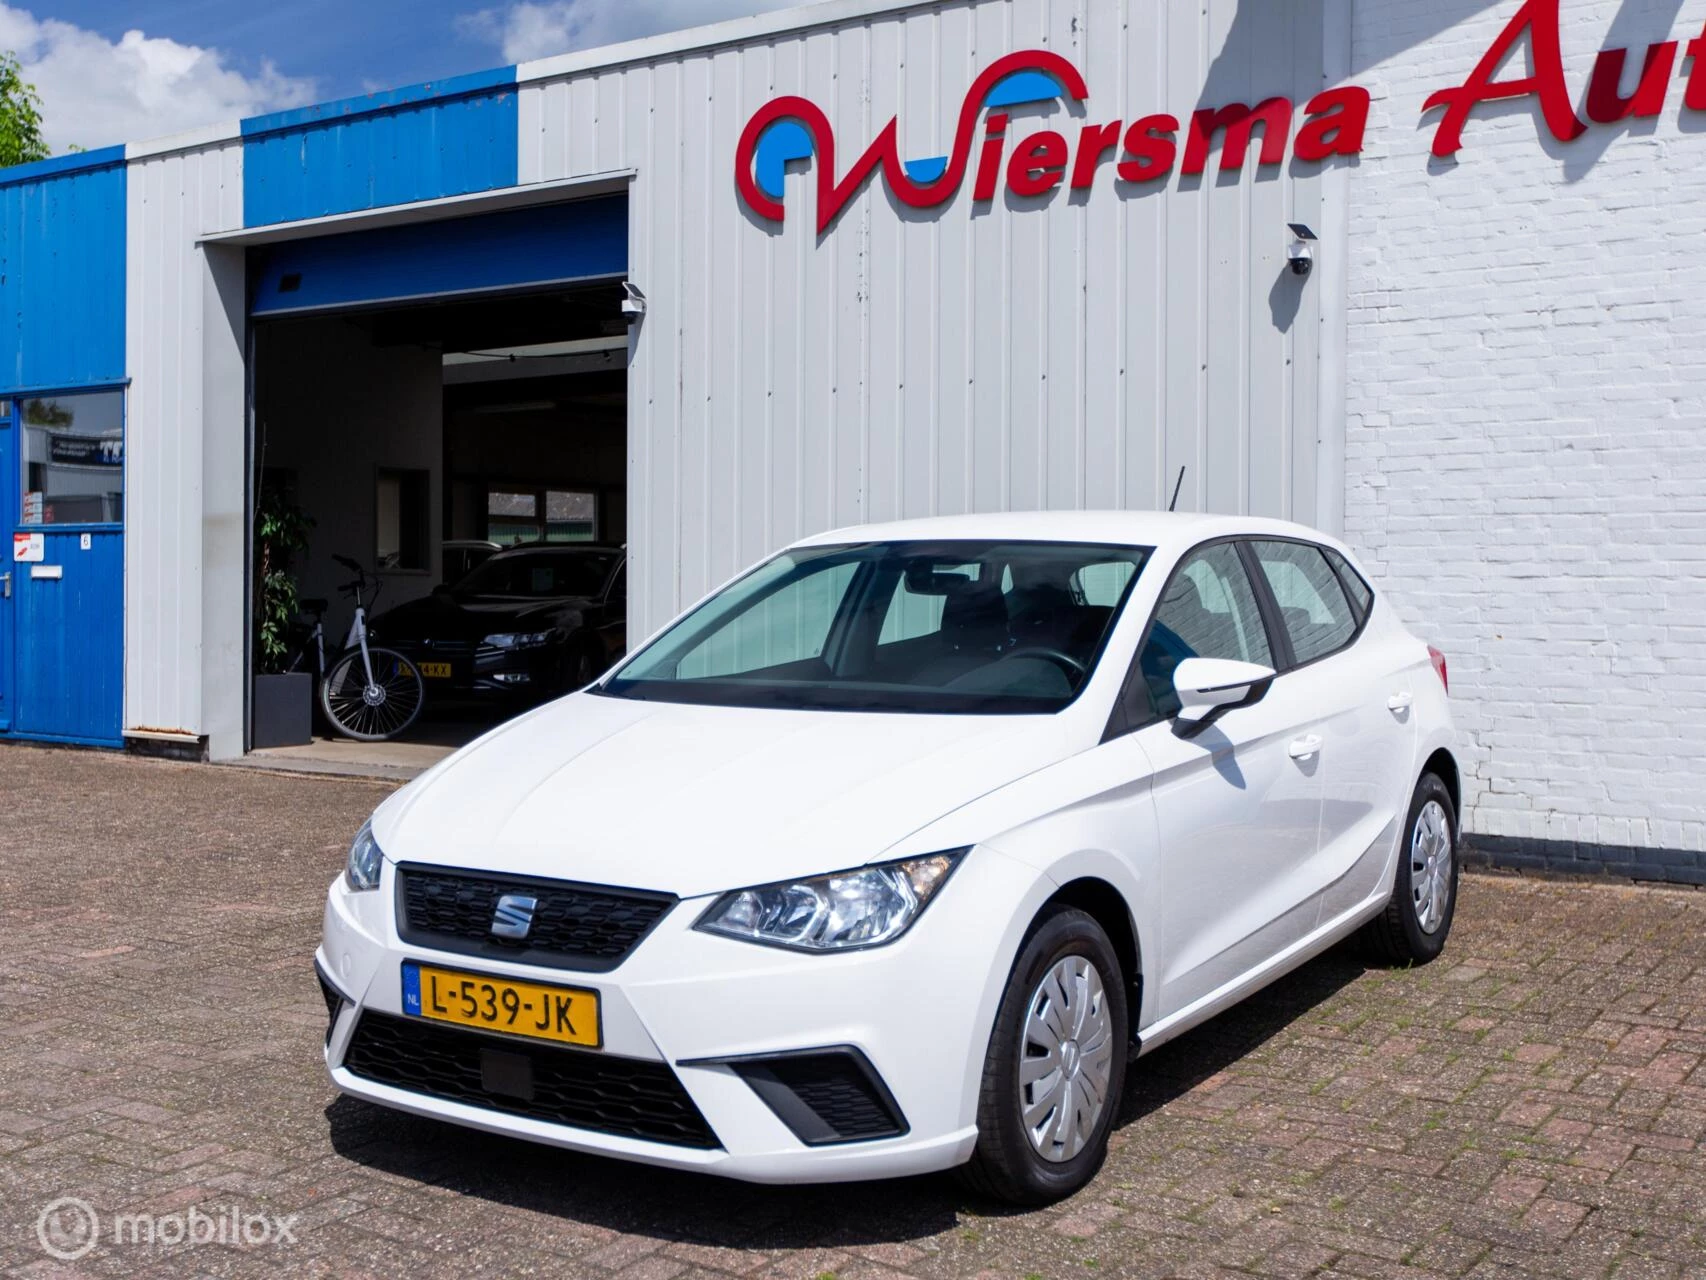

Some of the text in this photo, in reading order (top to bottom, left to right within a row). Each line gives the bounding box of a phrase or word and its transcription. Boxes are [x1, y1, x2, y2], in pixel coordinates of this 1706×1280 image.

[735, 49, 1370, 236] Wiersma
[407, 993, 419, 1007] NL
[431, 975, 577, 1036] L-539-JK
